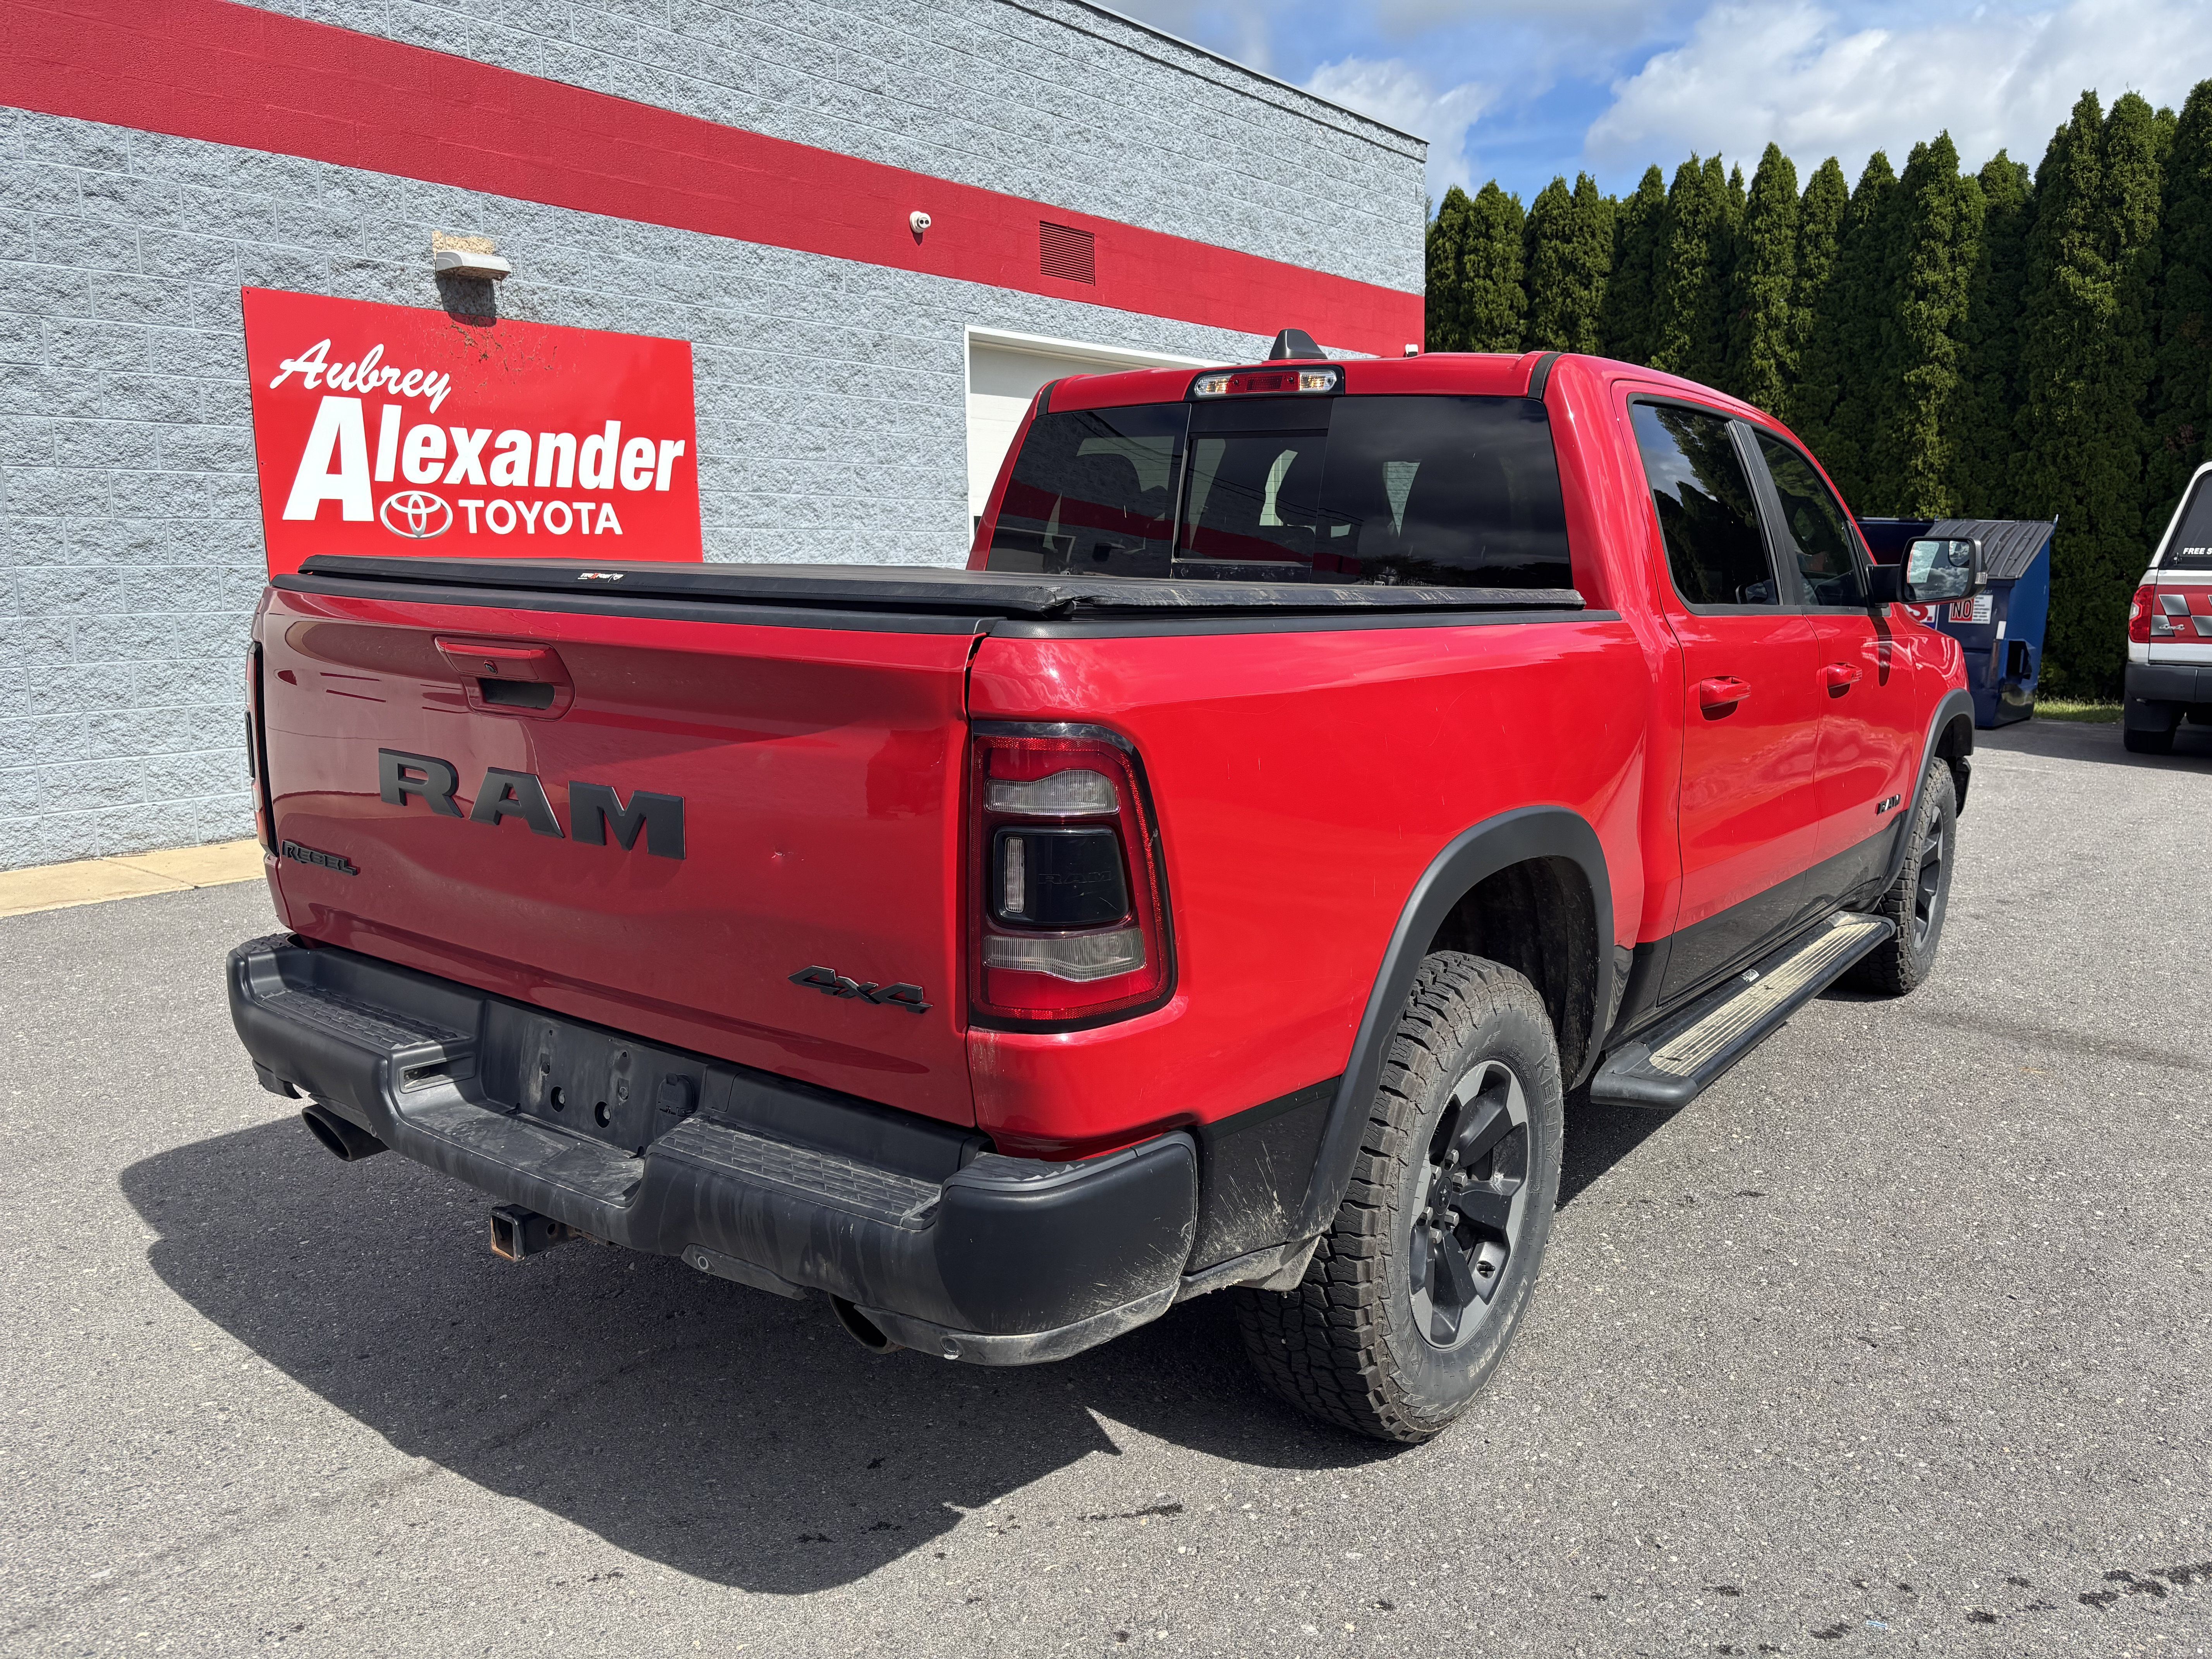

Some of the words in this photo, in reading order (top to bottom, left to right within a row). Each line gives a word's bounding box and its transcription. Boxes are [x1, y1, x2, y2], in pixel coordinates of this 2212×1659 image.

[269, 338, 452, 414] Aubrey
[282, 395, 685, 522] Alexander
[459, 499, 623, 535] TOYOTA
[1953, 600, 1972, 618] NO
[378, 748, 686, 860] RAM
[1876, 794, 1901, 816] RAM
[282, 840, 358, 876] REBEL
[1037, 871, 1111, 884] RAM
[1535, 1053, 1558, 1167] KELLY
